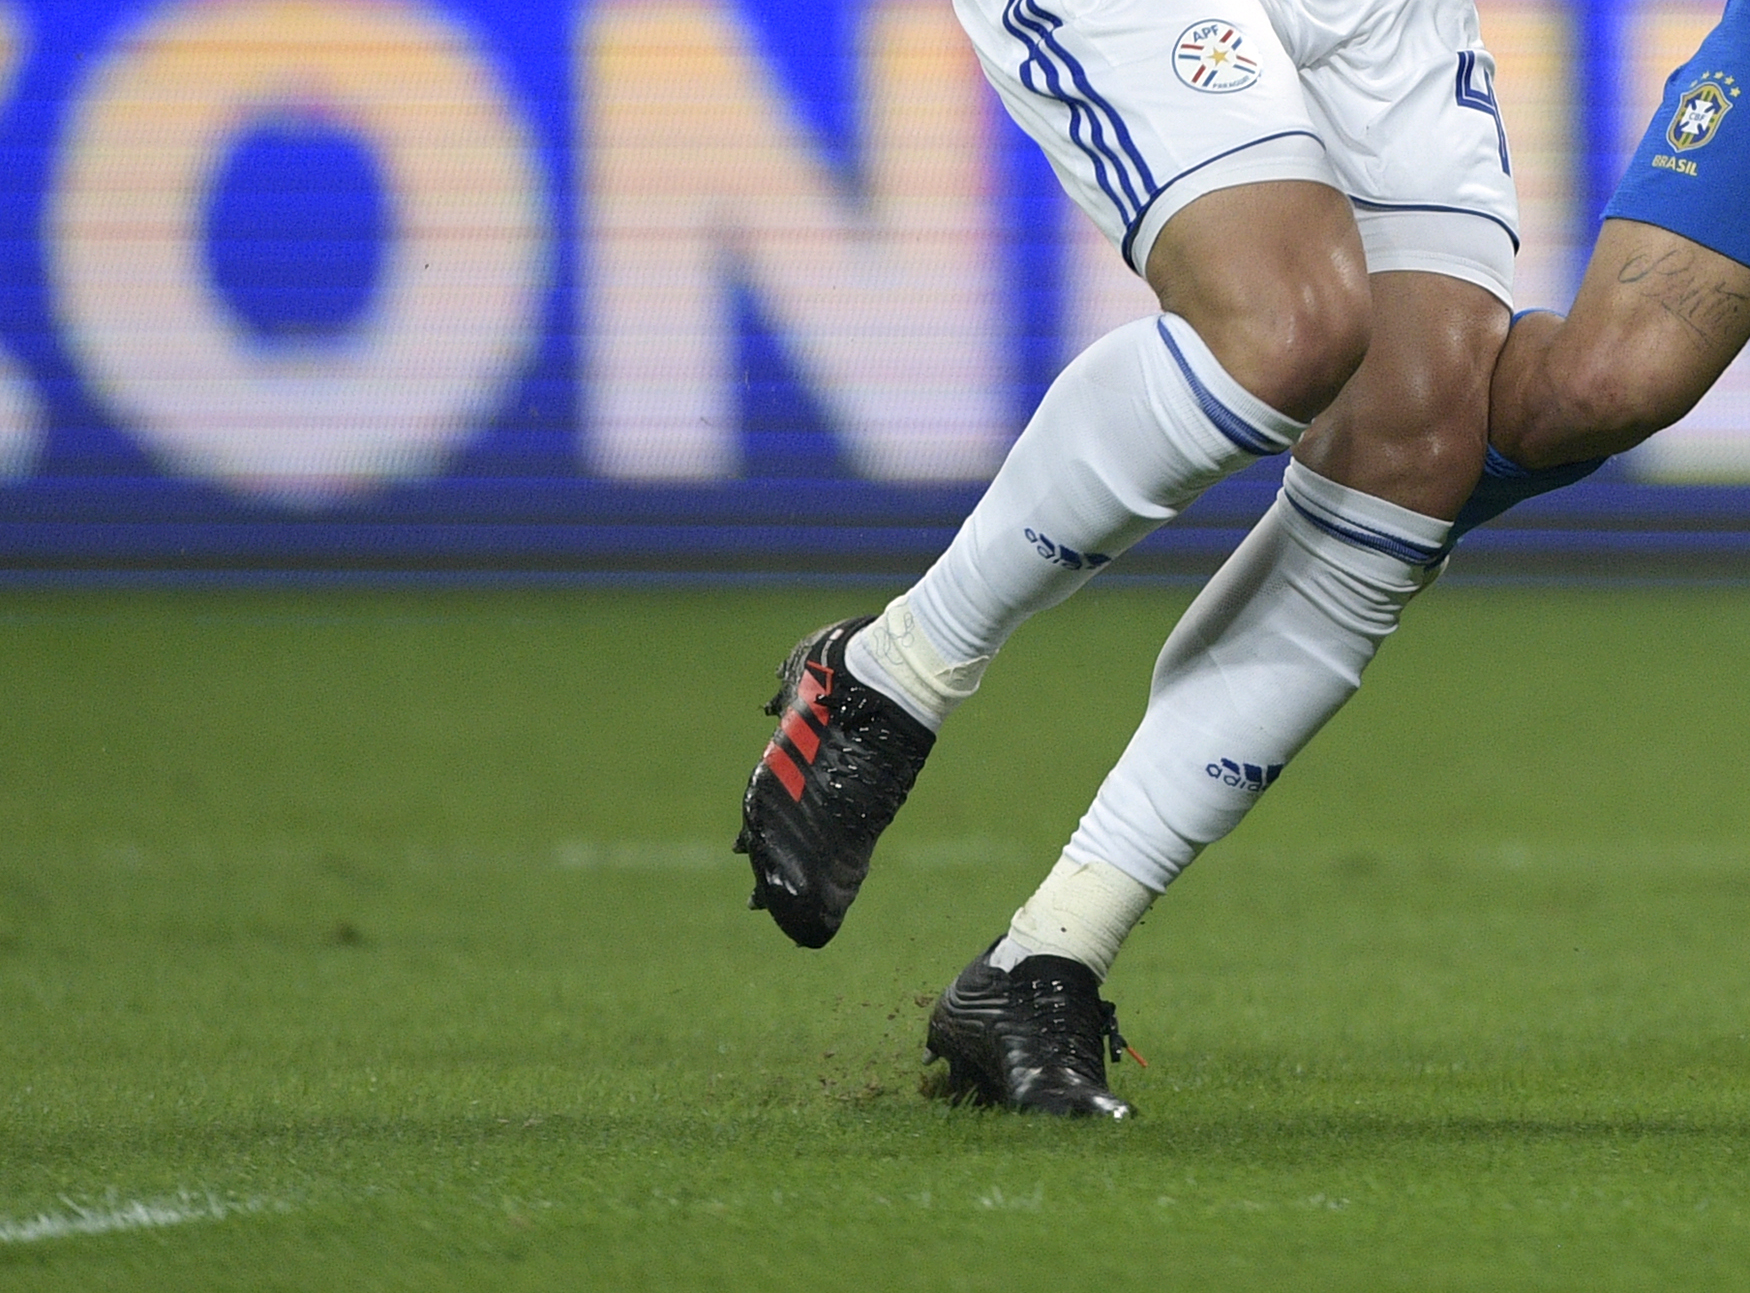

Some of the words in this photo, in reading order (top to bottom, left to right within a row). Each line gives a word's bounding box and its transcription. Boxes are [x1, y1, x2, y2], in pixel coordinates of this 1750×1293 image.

[1193, 24, 1219, 43] APF
[1455, 50, 1511, 177] 4
[1688, 111, 1706, 122] CBF
[1651, 154, 1698, 176] BRASIL
